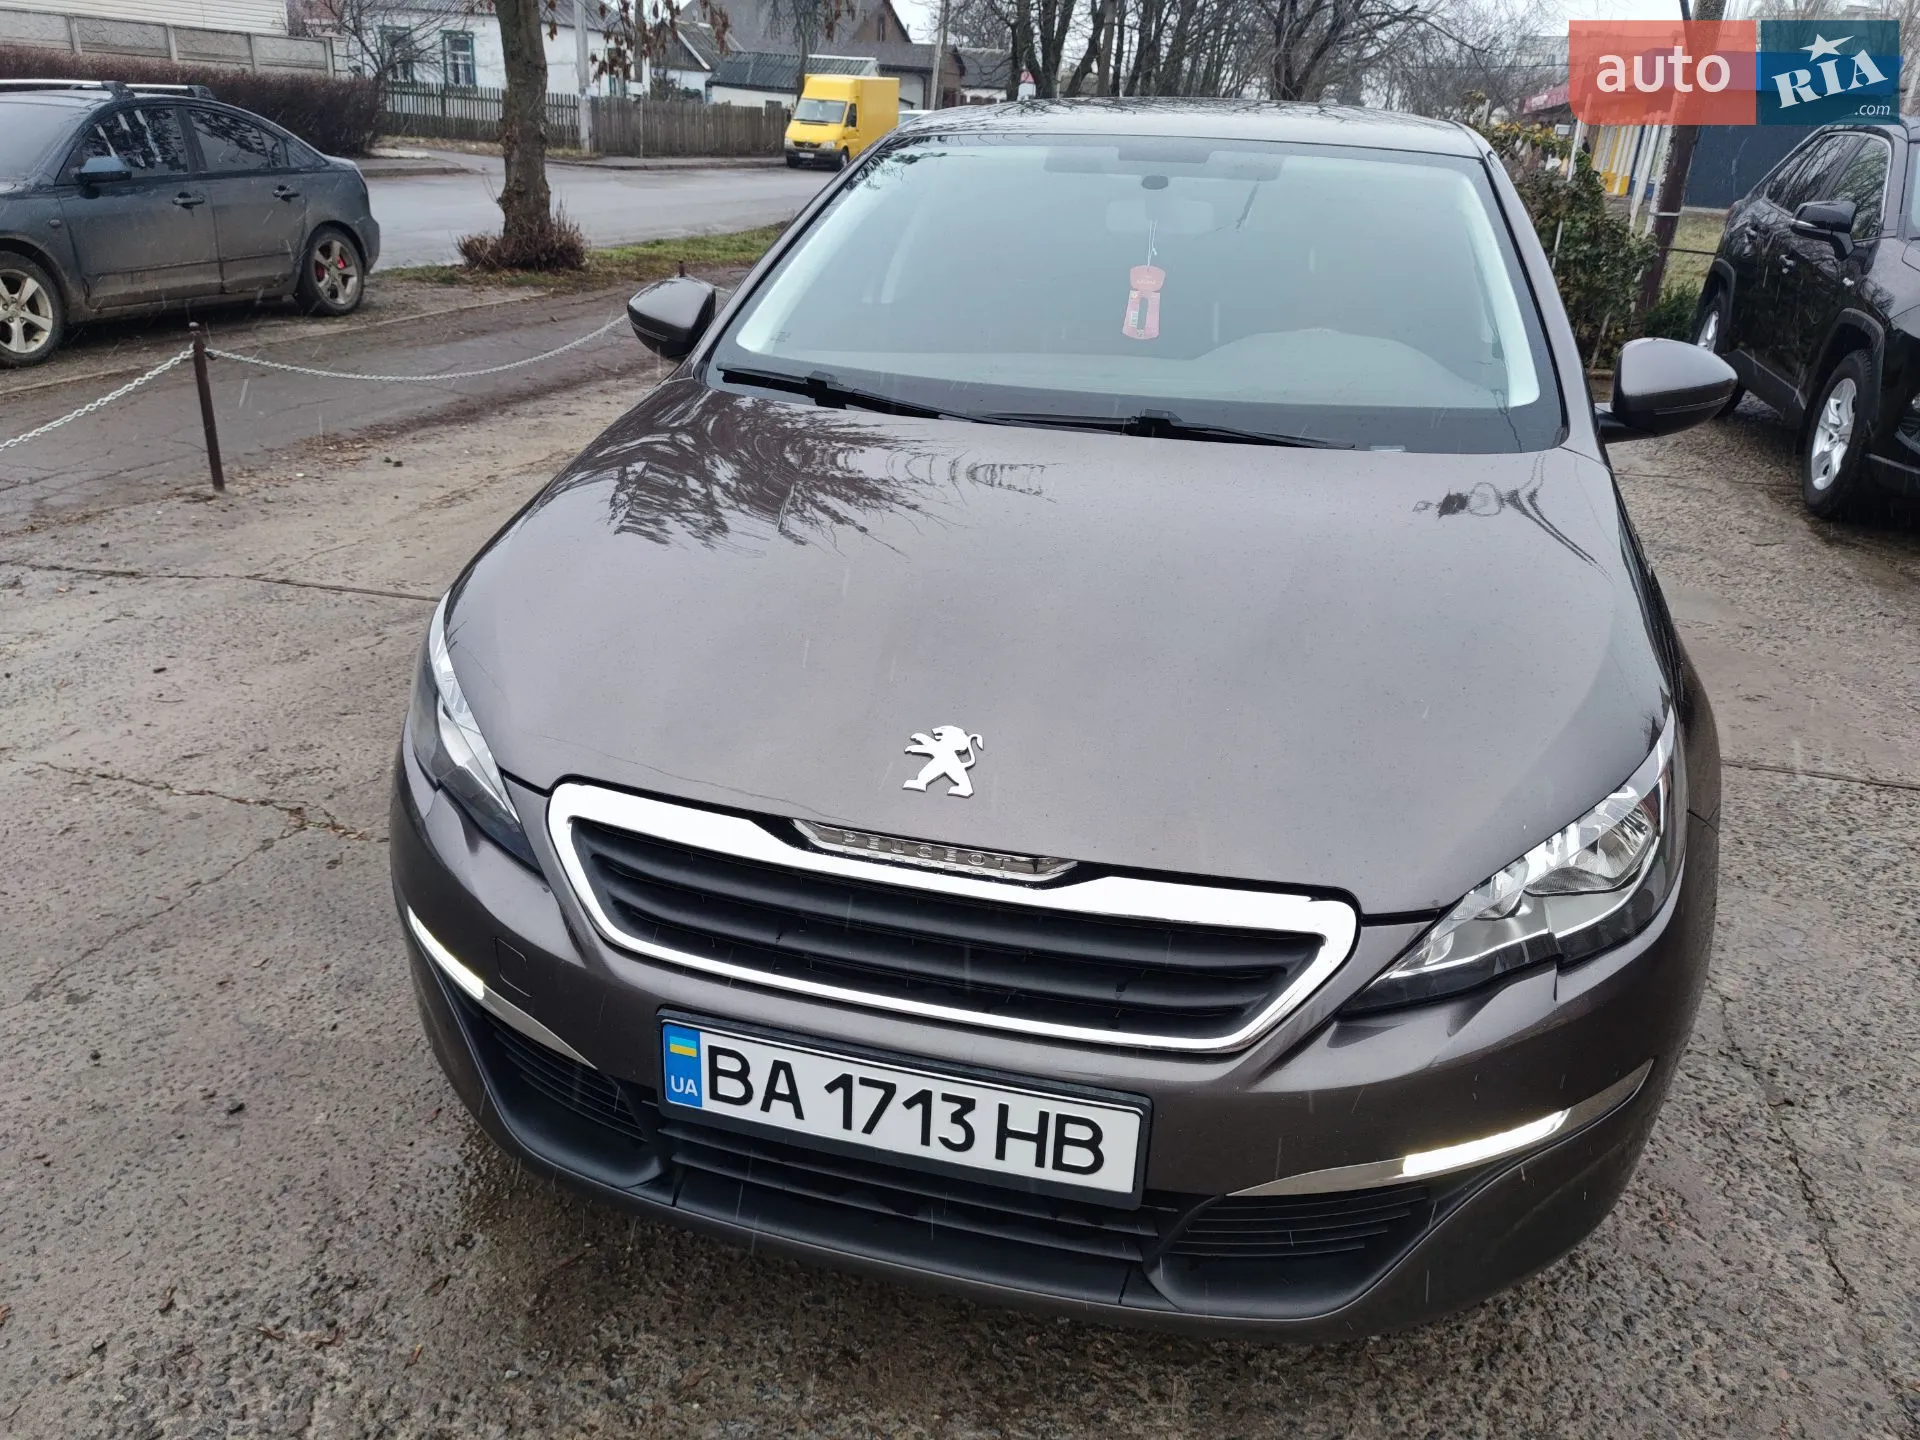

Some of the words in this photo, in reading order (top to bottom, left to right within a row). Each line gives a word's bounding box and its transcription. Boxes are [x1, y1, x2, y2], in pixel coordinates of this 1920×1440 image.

[670, 1074, 698, 1097] UA
[708, 1044, 805, 1120] BA
[824, 1073, 976, 1152] 1713
[995, 1102, 1105, 1175] HB
